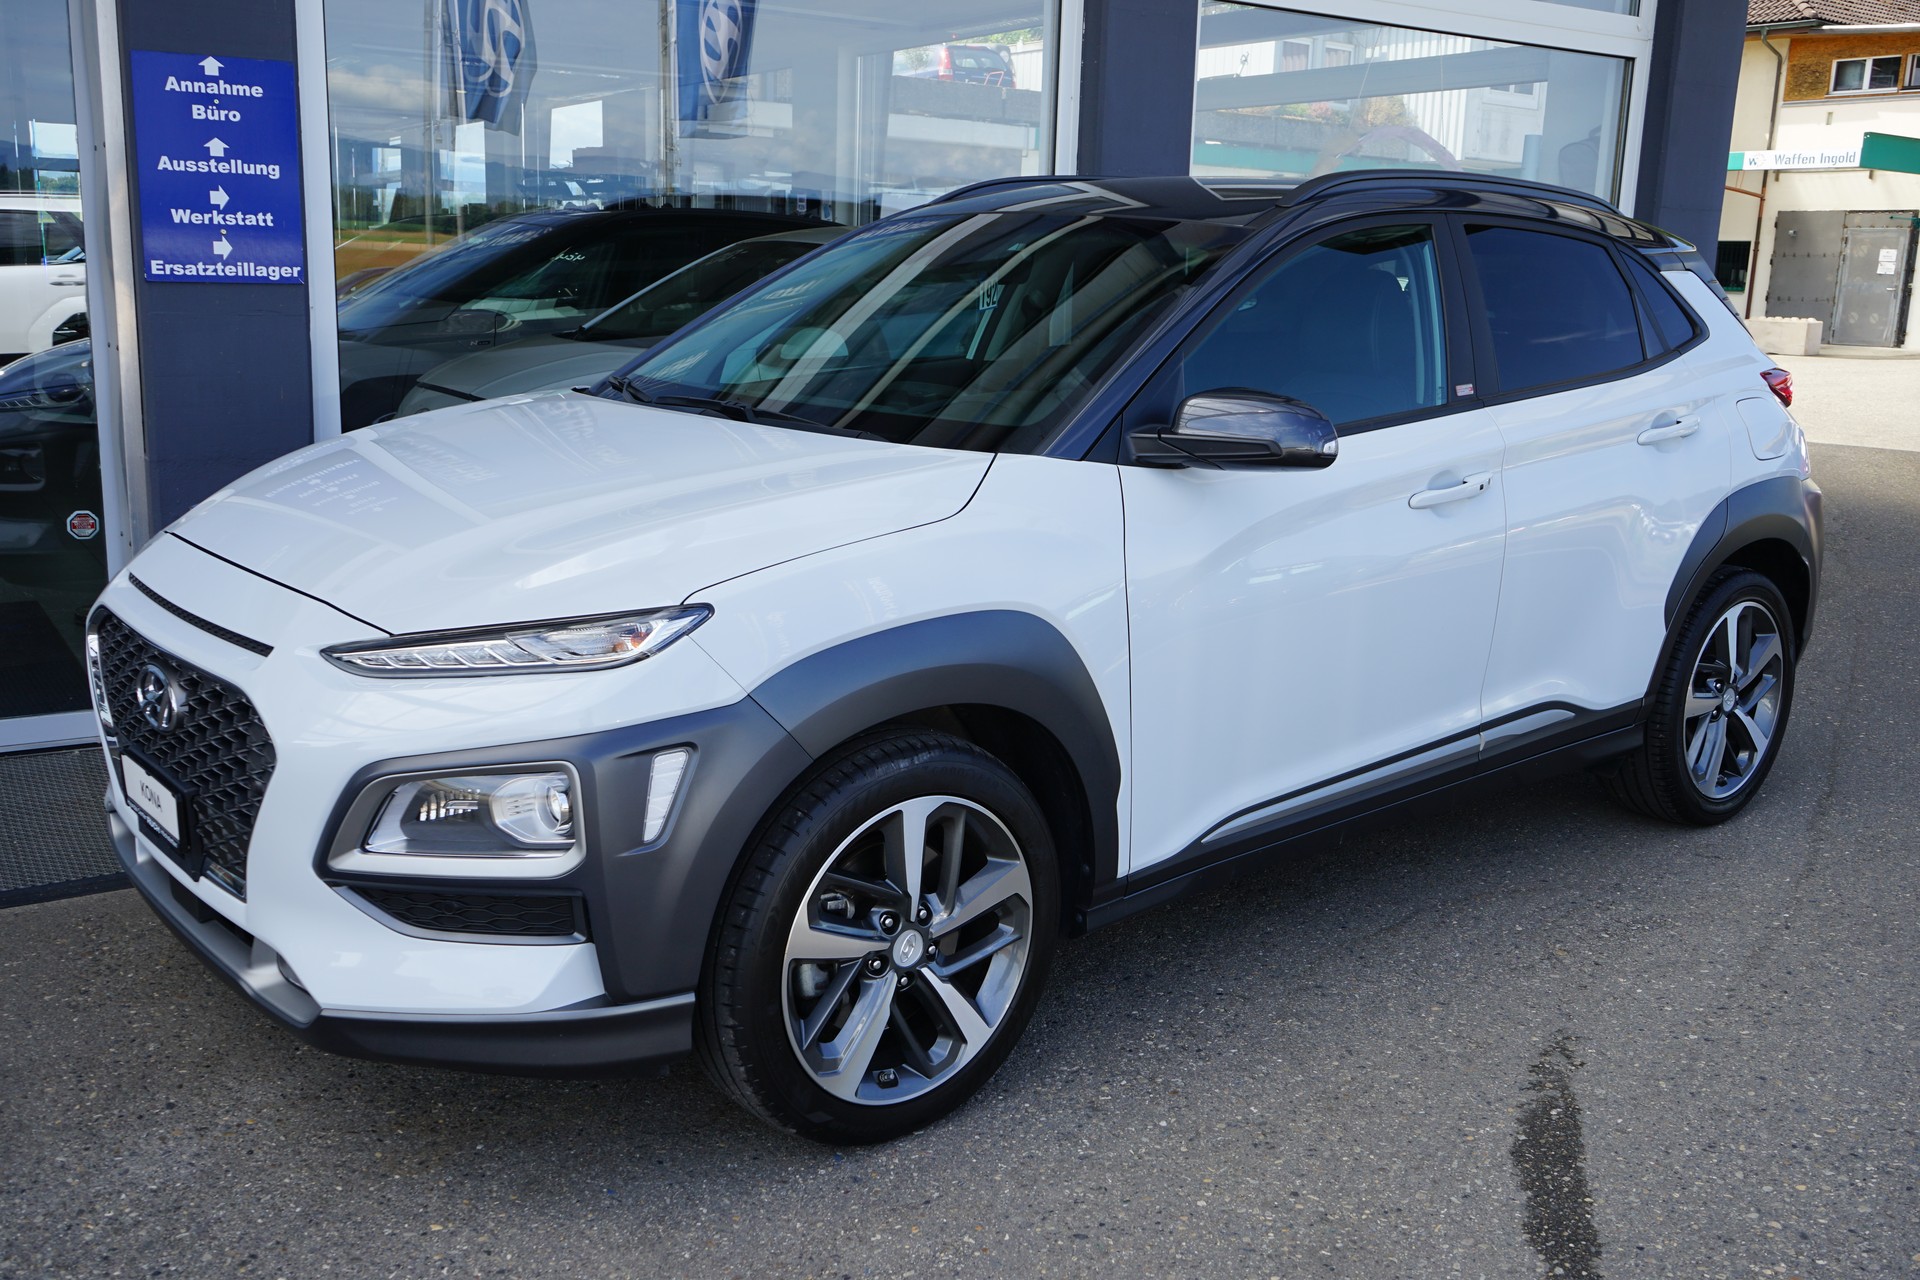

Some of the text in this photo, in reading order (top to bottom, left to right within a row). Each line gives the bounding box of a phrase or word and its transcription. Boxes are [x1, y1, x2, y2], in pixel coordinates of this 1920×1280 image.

[165, 76, 264, 98] Annahme
[191, 104, 241, 122] Büro
[157, 155, 281, 180] Ausstellung
[1774, 151, 1857, 166] Waffen Ingold
[170, 208, 274, 227] Werkstatt
[150, 259, 301, 281] Ersatzteillager
[140, 780, 163, 813] KONA
